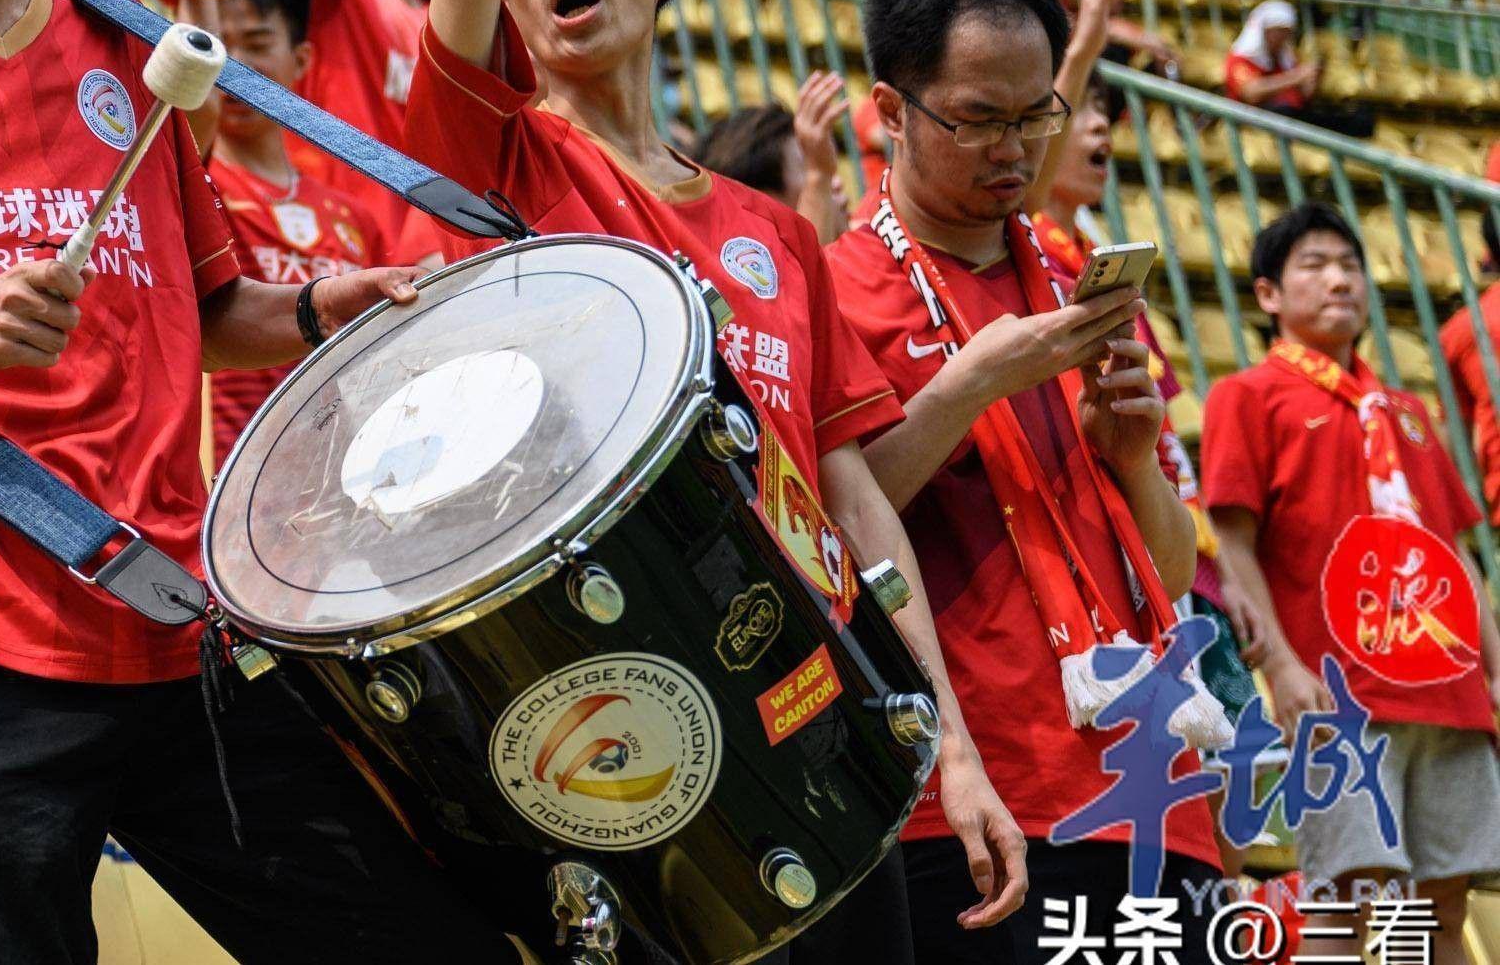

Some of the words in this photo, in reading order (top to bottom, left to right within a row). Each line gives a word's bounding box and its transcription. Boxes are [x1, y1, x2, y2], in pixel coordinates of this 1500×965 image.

[515, 667, 617, 725] COLLEGE
[624, 667, 679, 697] FANS
[769, 683, 797, 710] WE
[796, 658, 826, 692] ARE
[773, 676, 836, 734] CANTON
[502, 726, 523, 764] THE
[621, 730, 642, 760] 2001
[677, 695, 706, 766] UNION
[680, 772, 700, 804] OF
[528, 800, 679, 840] GUANGZHOU
